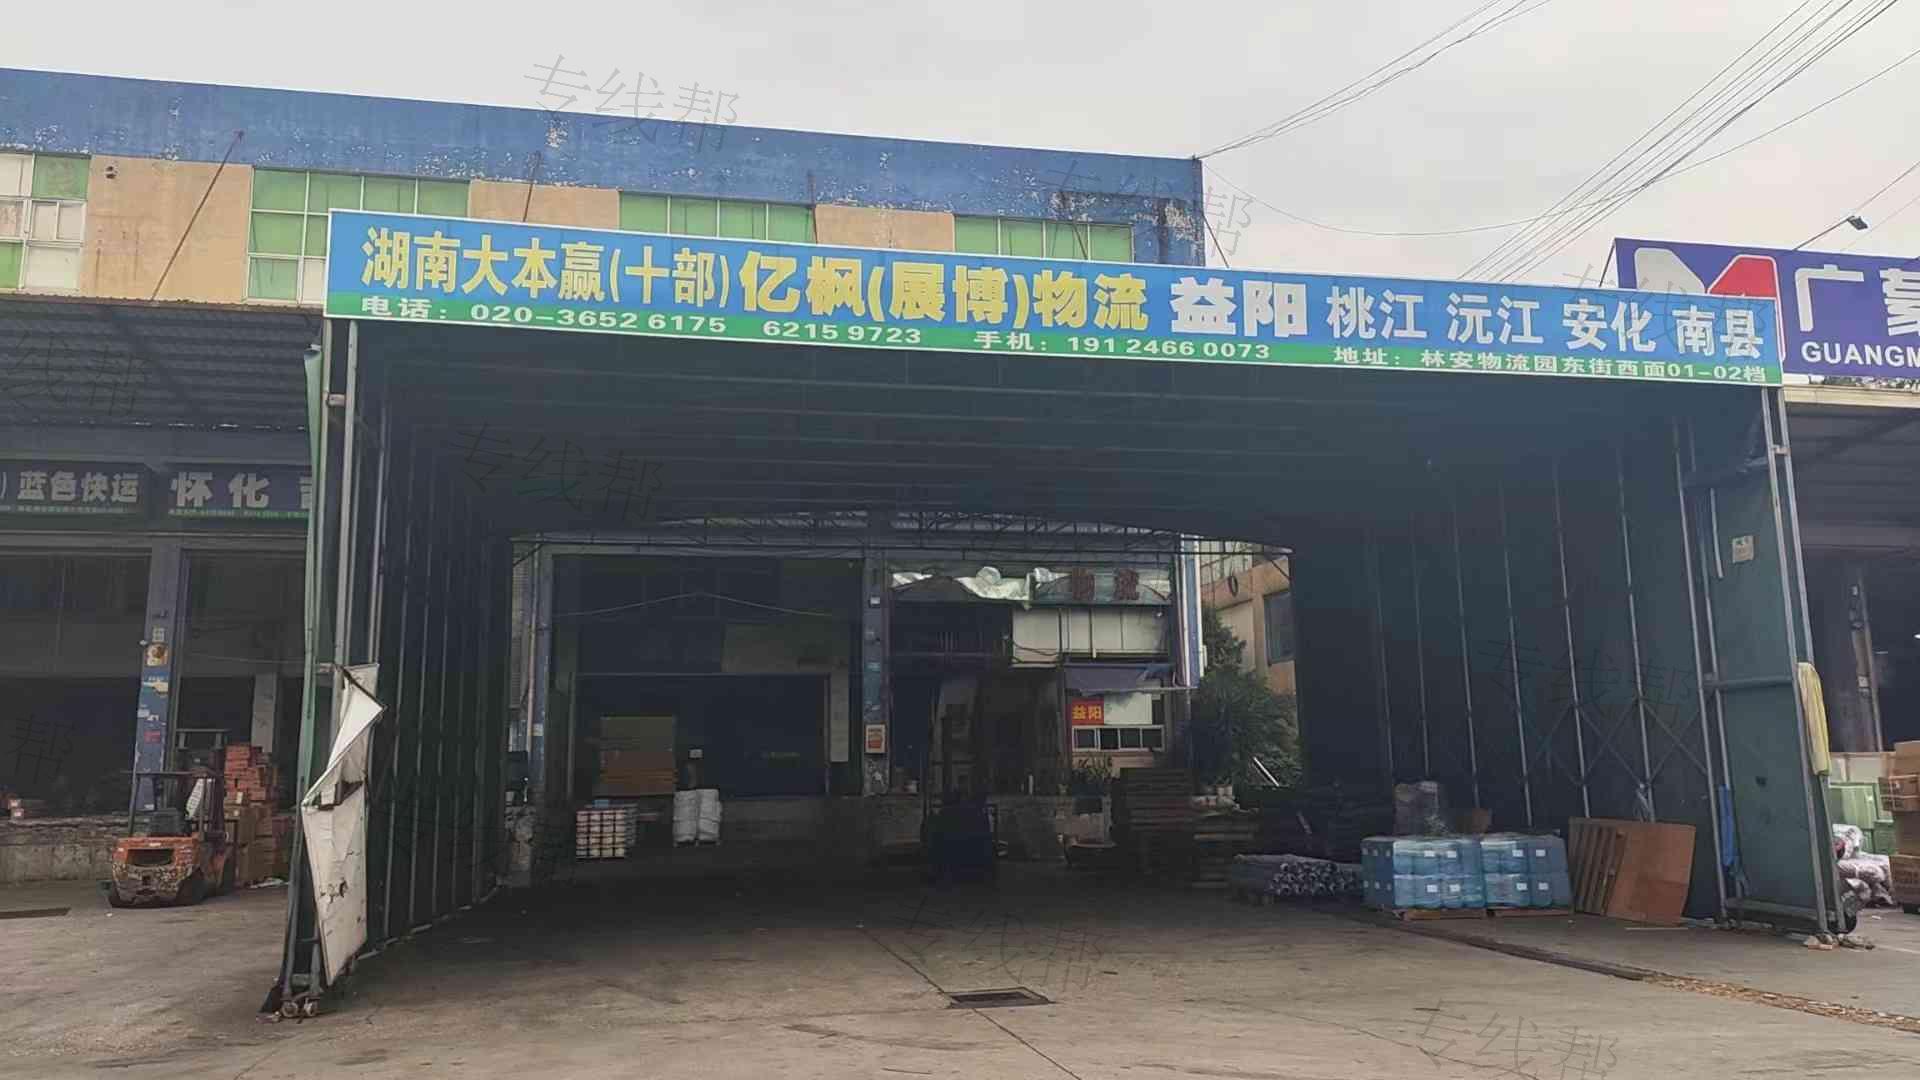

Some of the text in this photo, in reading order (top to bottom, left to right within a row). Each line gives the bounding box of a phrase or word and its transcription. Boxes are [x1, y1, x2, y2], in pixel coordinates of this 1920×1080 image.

[1169, 276, 1308, 338] 益阳
[1326, 286, 1428, 339] 桃江
[1446, 291, 1544, 345] 沅江
[1562, 298, 1657, 352] 安化
[1671, 304, 1764, 359] 南县
[171, 472, 270, 508] 怀化
[1072, 704, 1102, 720] 益阳
